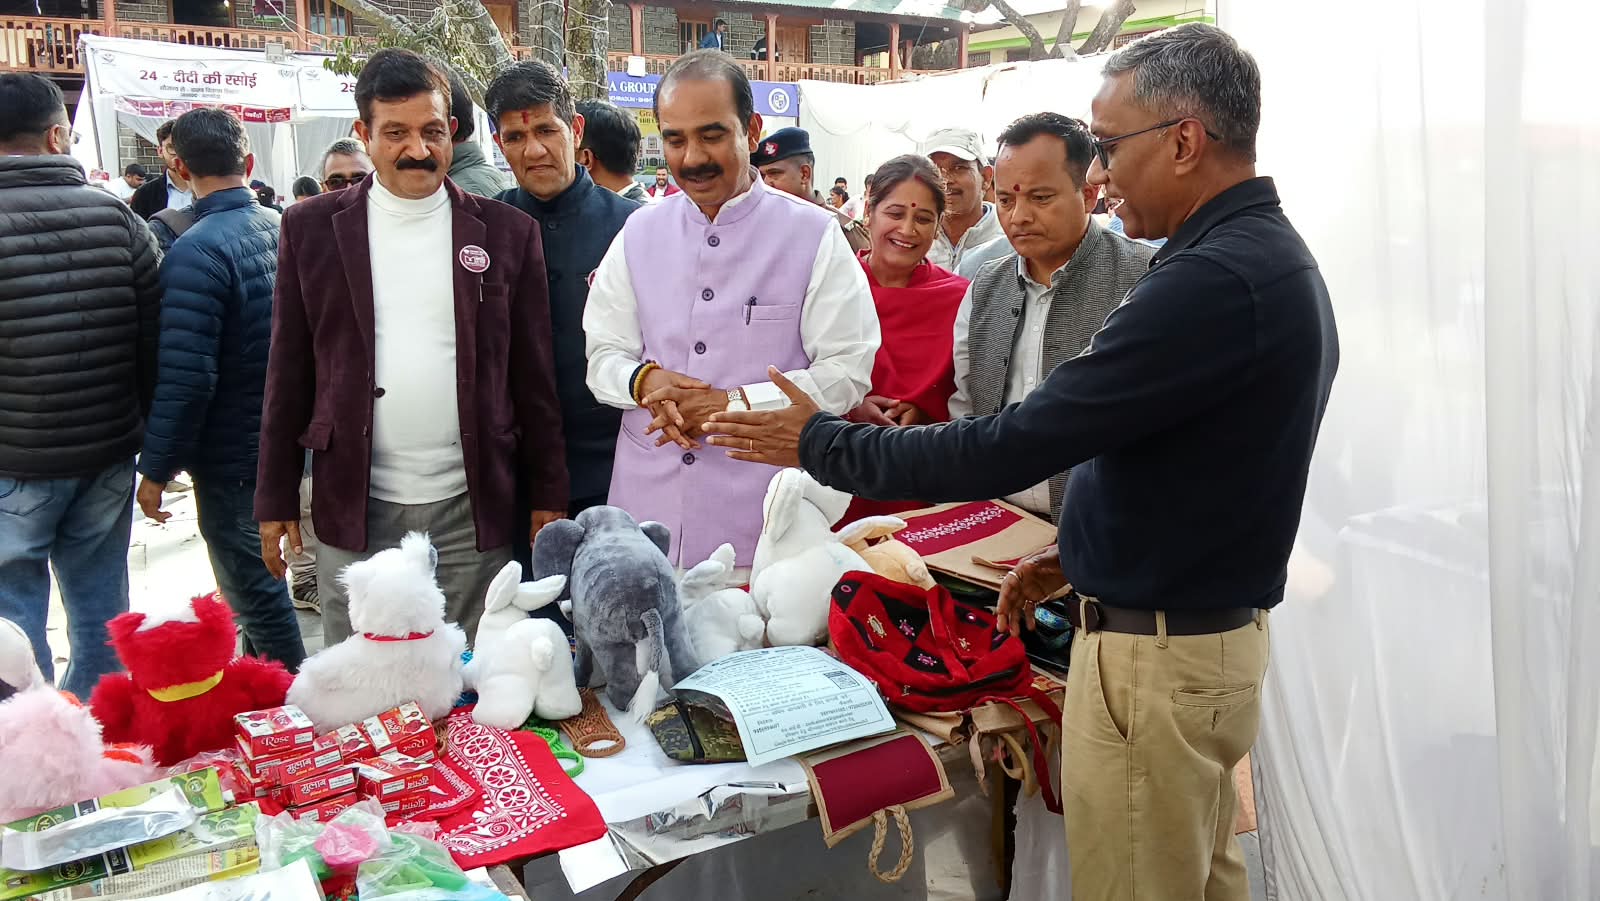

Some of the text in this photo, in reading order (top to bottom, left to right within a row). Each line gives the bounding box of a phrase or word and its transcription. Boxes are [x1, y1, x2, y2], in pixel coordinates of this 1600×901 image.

[139, 70, 158, 81] 24
[173, 70, 198, 84] दीदी
[203, 71, 222, 85] की
[225, 72, 258, 88] रसोई
[620, 81, 656, 94] GROUP
[261, 735, 290, 746] Rose
[402, 739, 428, 752] Rose
